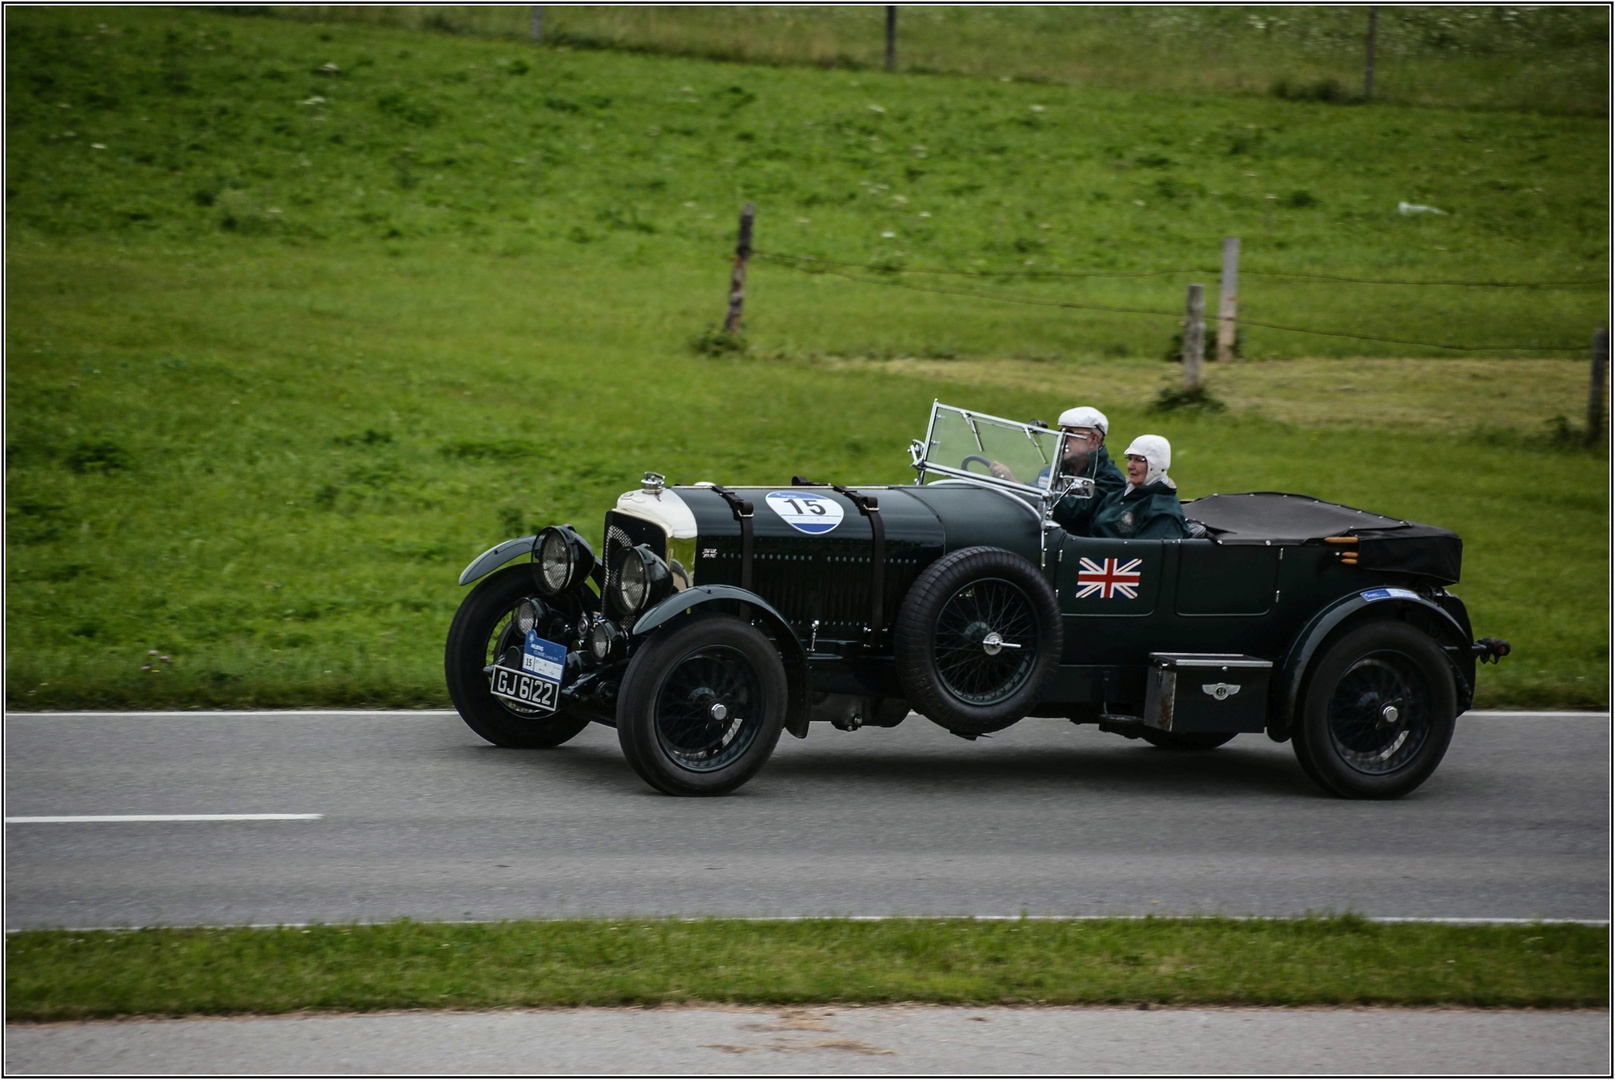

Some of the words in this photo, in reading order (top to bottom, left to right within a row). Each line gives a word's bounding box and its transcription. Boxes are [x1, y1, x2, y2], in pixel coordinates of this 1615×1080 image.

[784, 499, 826, 515] 15
[526, 658, 532, 667] 15
[498, 671, 517, 695] GJ
[519, 677, 552, 705] 6122
